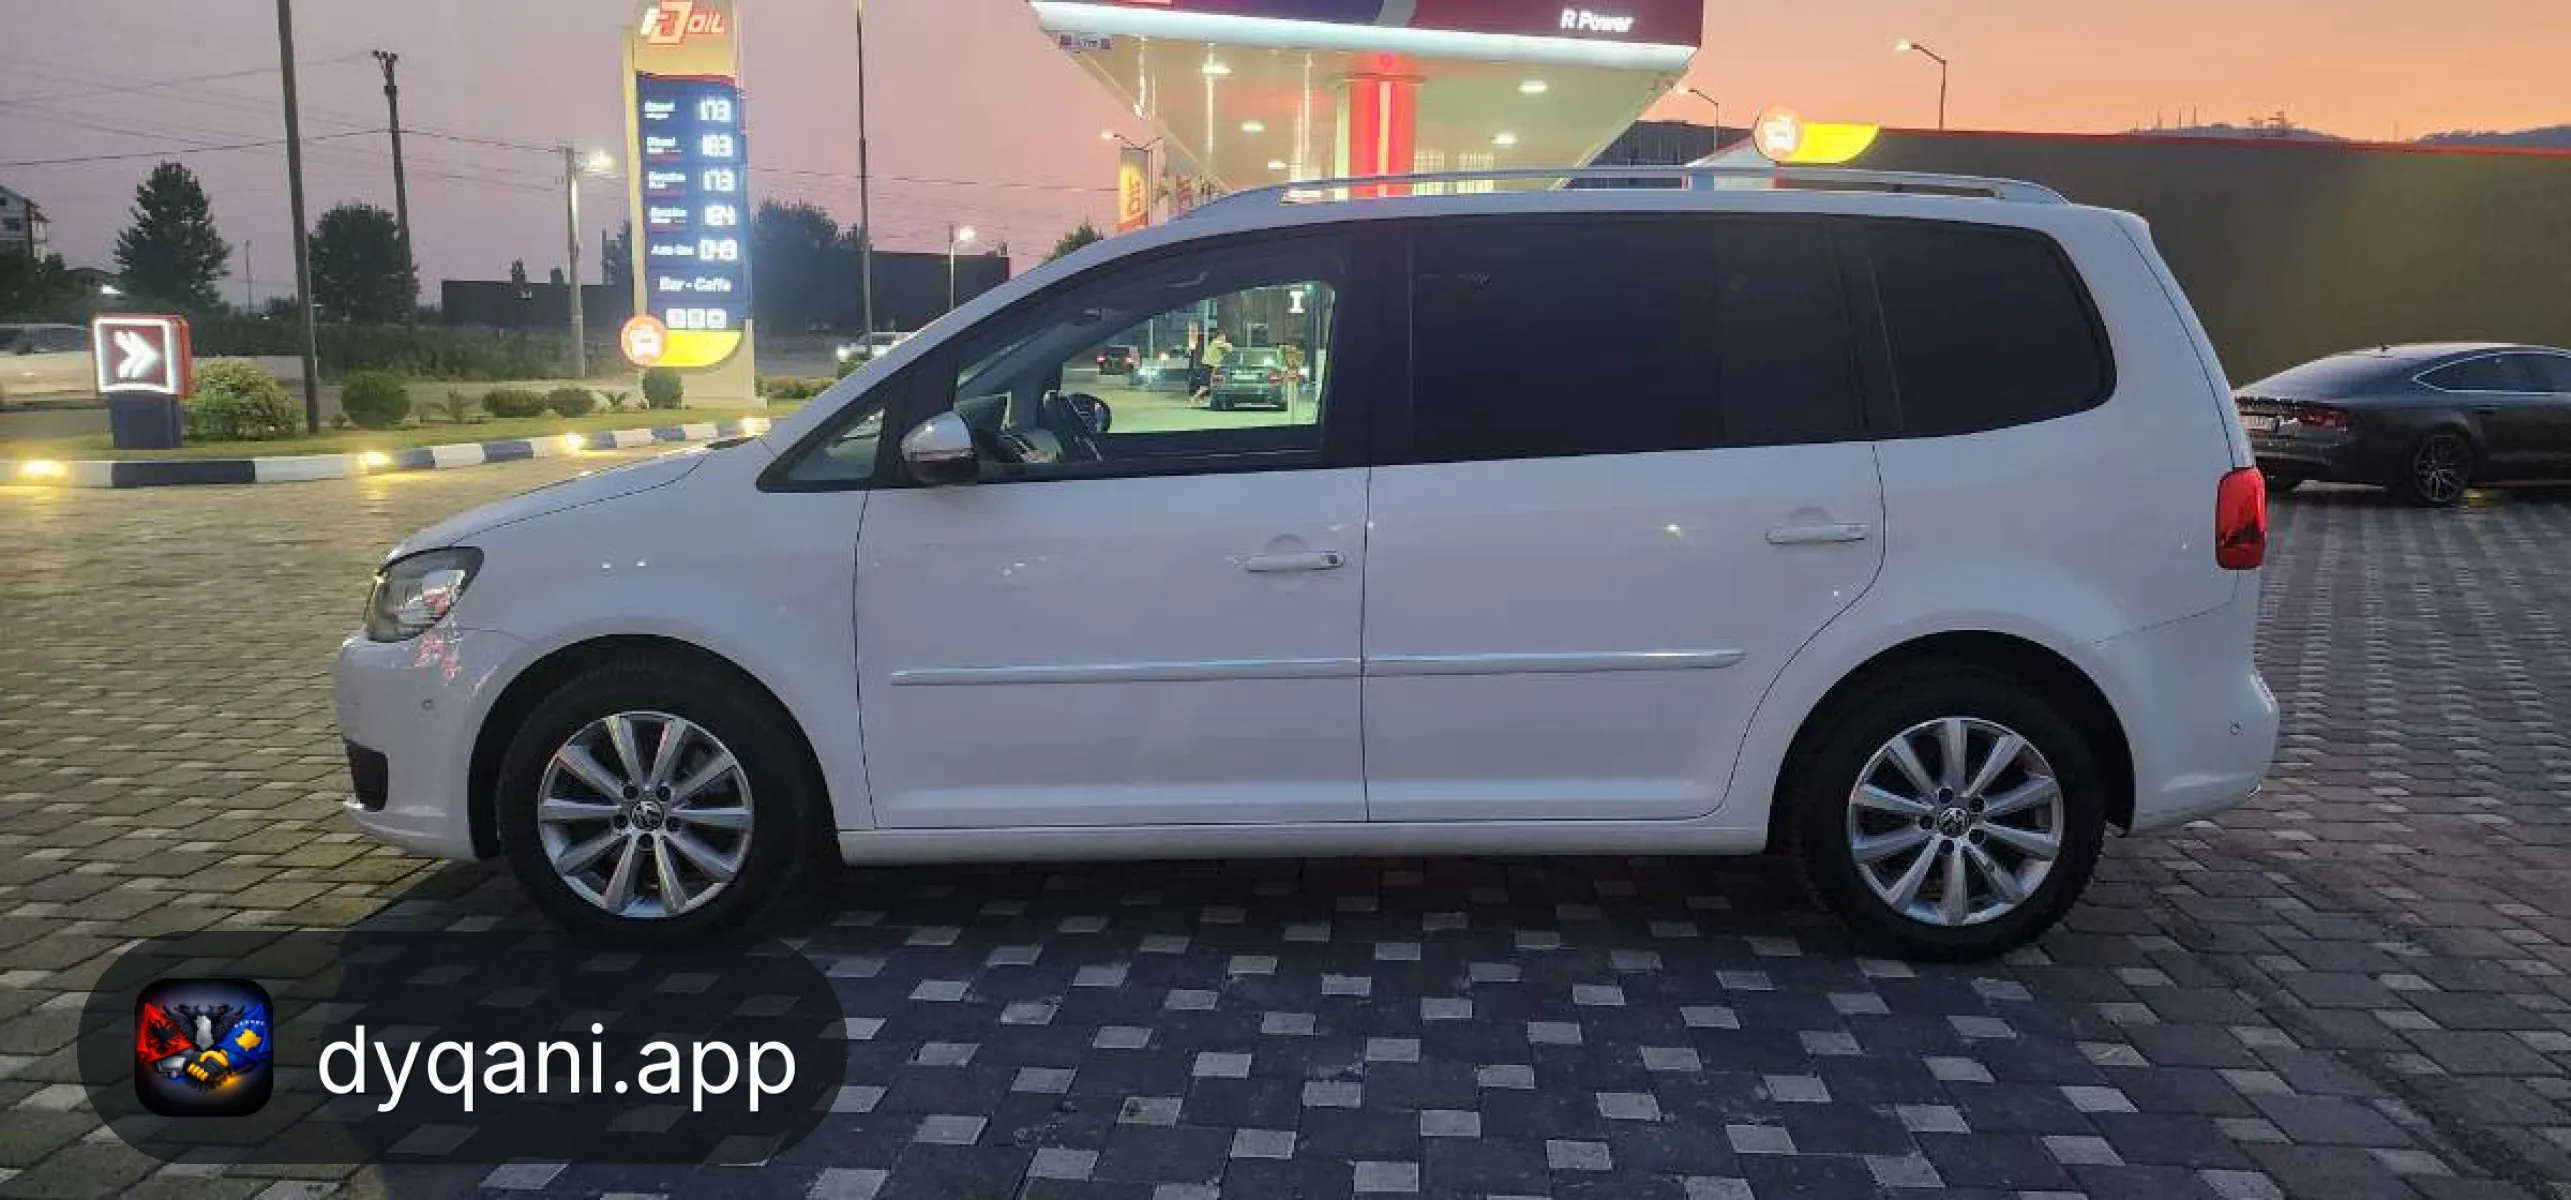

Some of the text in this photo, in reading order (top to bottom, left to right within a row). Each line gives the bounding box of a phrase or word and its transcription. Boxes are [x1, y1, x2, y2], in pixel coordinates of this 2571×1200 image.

[688, 14, 724, 33] OIL
[1560, 9, 1634, 32] R Power
[660, 276, 685, 292] Bar
